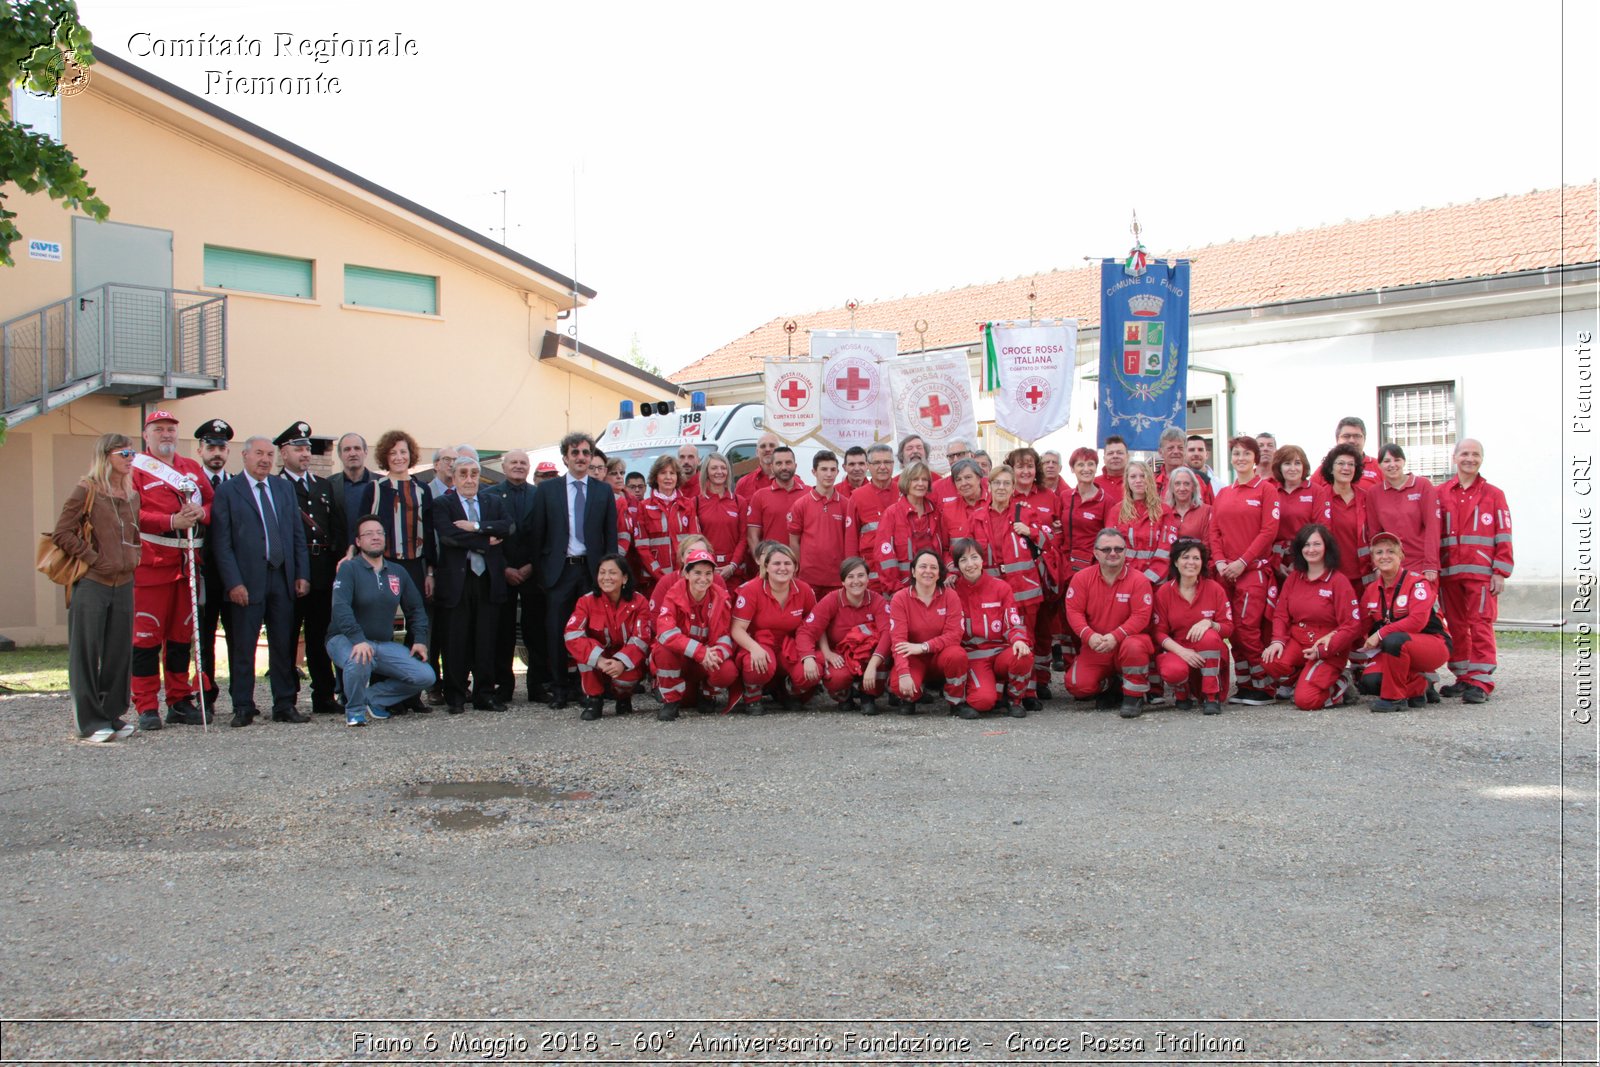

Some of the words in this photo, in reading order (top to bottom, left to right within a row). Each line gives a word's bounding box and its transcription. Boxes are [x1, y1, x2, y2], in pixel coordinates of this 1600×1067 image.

[30, 241, 60, 253] AVIS
[1106, 275, 1141, 297] COMUNE
[1145, 275, 1155, 284] DI
[1002, 346, 1032, 356] CROCE
[1035, 345, 1064, 354] ROSSA
[1014, 355, 1053, 365] ITALIANA
[1127, 355, 1137, 371] F
[896, 382, 914, 411] CROCE
[910, 372, 939, 386] ROSSA
[939, 373, 970, 401] ITALIANA
[682, 412, 702, 423] 118
[823, 417, 873, 426] DELEGAZIONE
[838, 429, 868, 438] MATHI
